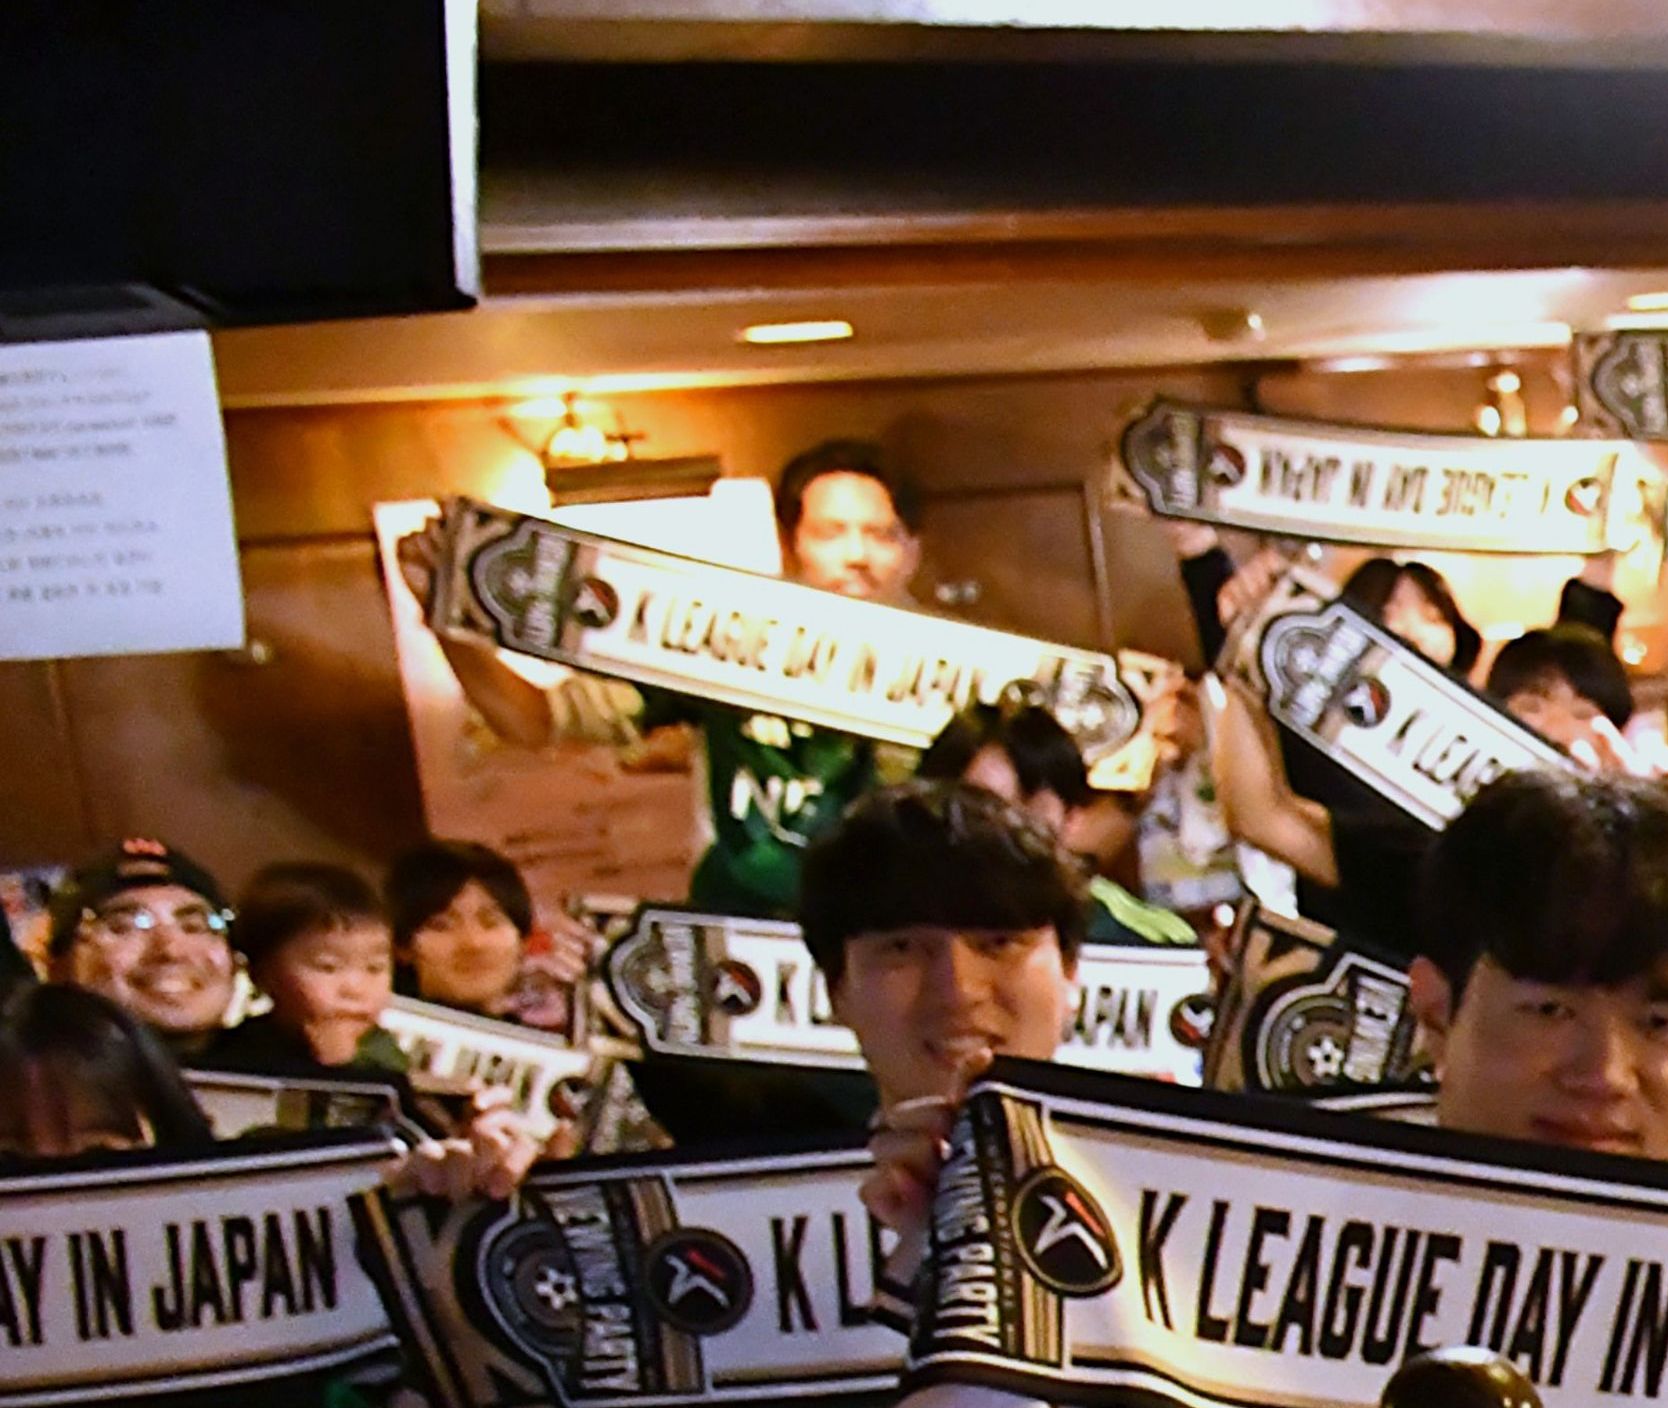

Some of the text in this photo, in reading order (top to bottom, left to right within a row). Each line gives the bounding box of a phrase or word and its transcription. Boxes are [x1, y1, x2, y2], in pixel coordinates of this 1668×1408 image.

[68, 1228, 134, 1341] IN
[152, 1206, 339, 1332] JAPAN
[769, 1216, 821, 1333] K
[1139, 1187, 1189, 1332] K
[1196, 1199, 1462, 1367] LEAGUE
[1467, 1238, 1605, 1388] DAY
